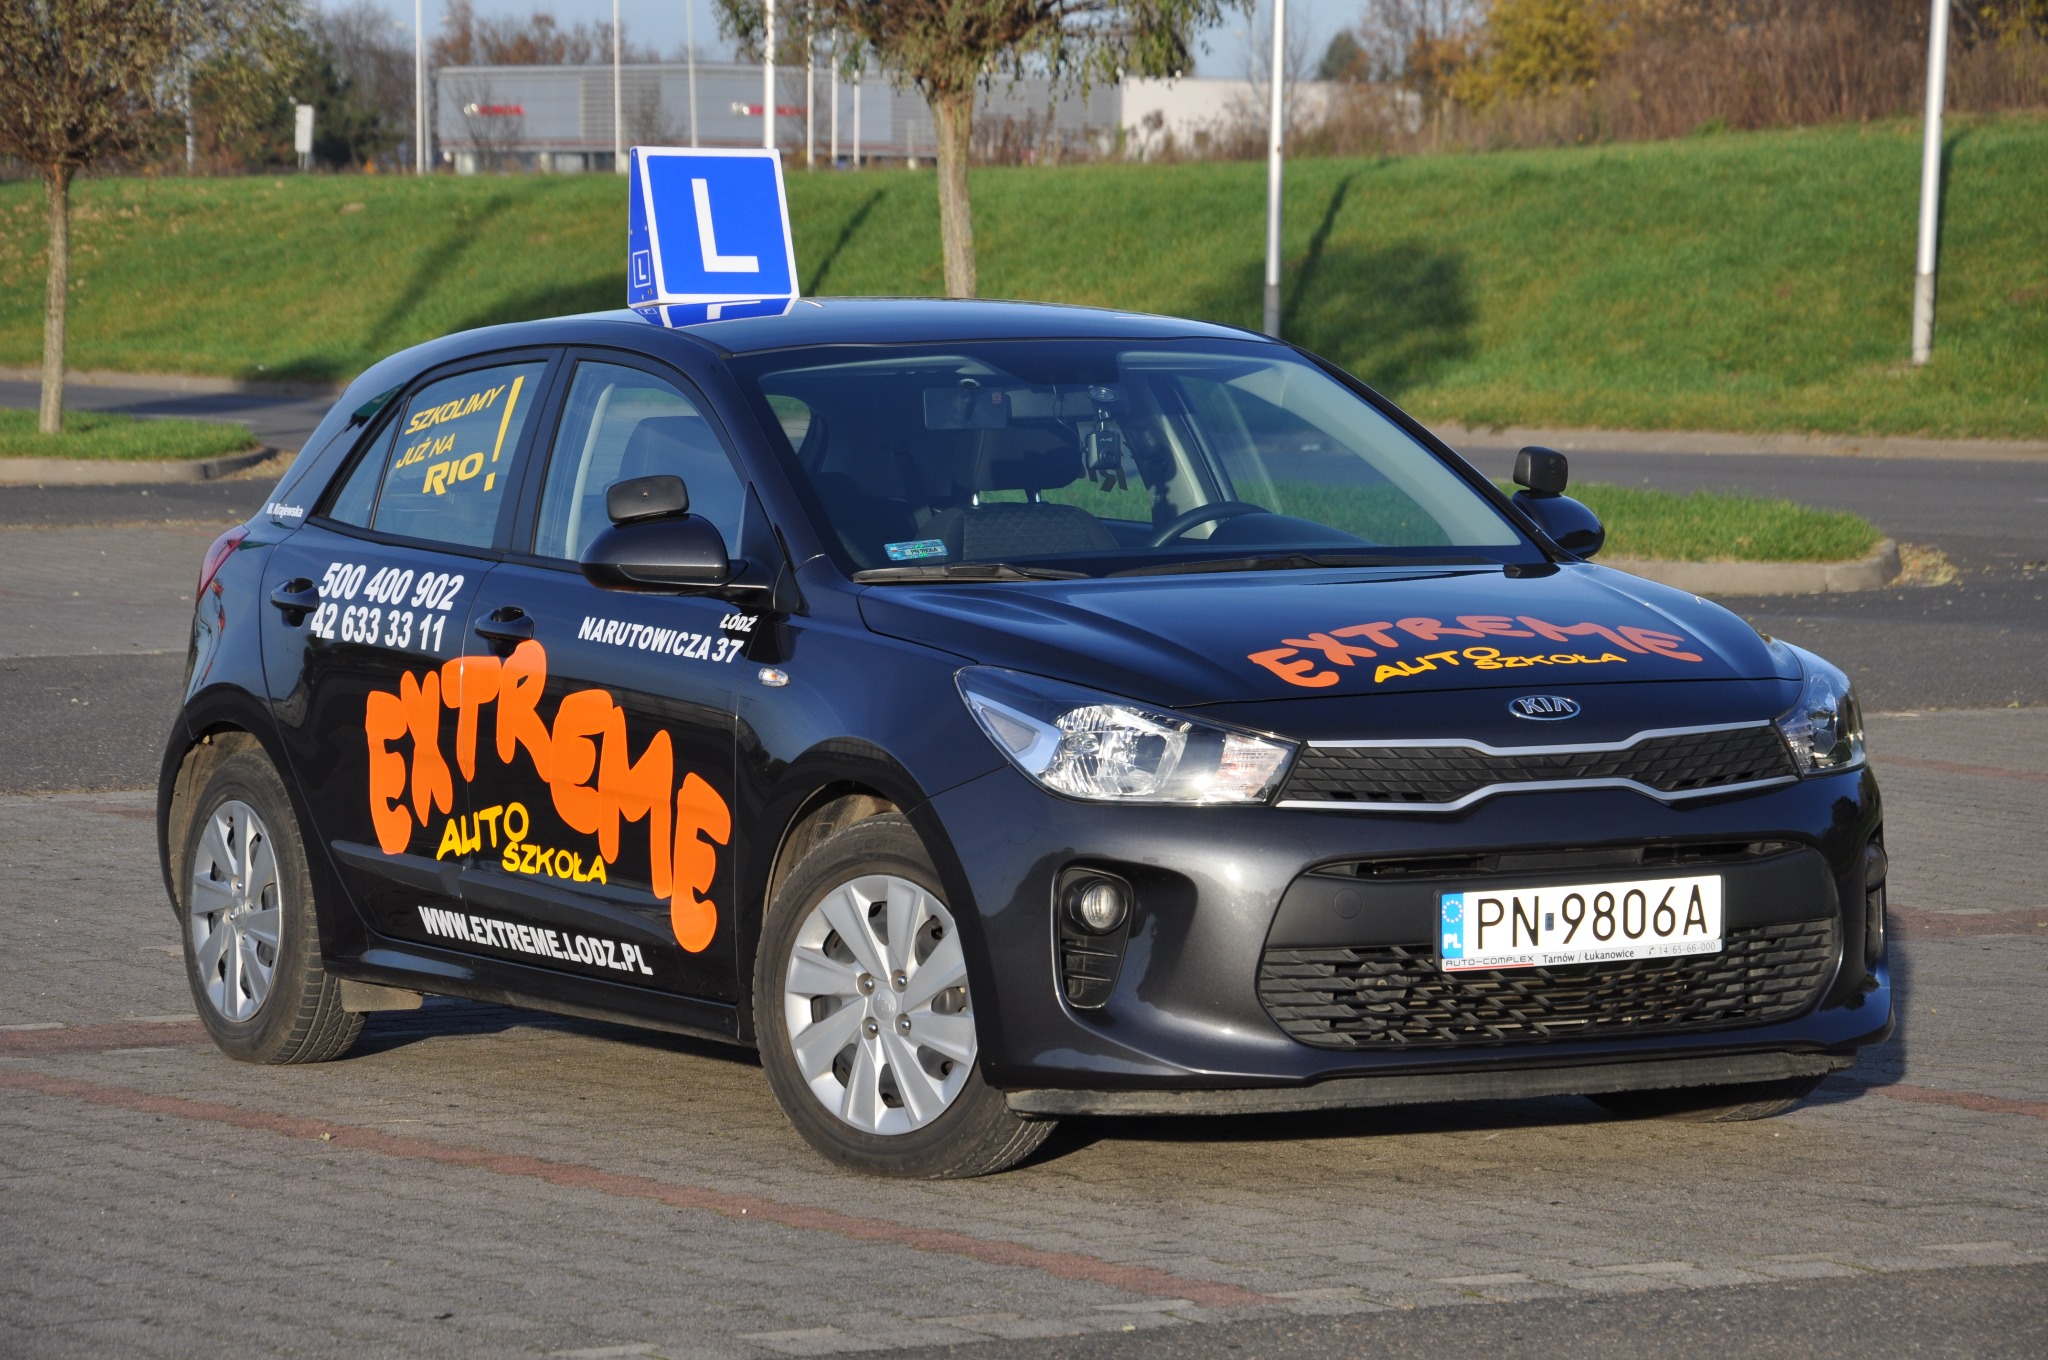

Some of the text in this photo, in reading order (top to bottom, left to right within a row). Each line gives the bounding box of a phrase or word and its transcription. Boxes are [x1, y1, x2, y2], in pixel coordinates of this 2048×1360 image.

[691, 178, 760, 273] L
[638, 258, 647, 281] L
[404, 384, 506, 435] SZKOLIMY
[396, 433, 456, 469] JUŻ NA
[318, 562, 465, 611] 500 400 902
[310, 602, 447, 652] 42 633 33 11
[577, 616, 745, 664] NARUTOWICZA 37
[719, 612, 759, 632] ŁÓDŹ
[1247, 615, 1704, 688] EXTREME
[1375, 646, 1500, 683] AUTO
[1473, 652, 1628, 670] SZKOŁA
[1518, 697, 1574, 714] KIA
[365, 639, 731, 953] EXTREME
[436, 802, 530, 861] AUTO
[502, 841, 607, 885] SZKOŁA
[417, 905, 654, 976] WWW.EXTREME.LODZ.PL
[1443, 933, 1461, 949] PL
[1477, 884, 1708, 950] PN 9806A
[1445, 955, 1534, 967] AUTO-COMPLEX
[1542, 952, 1575, 964] Tarnów
[1584, 949, 1635, 961] Łukanowice
